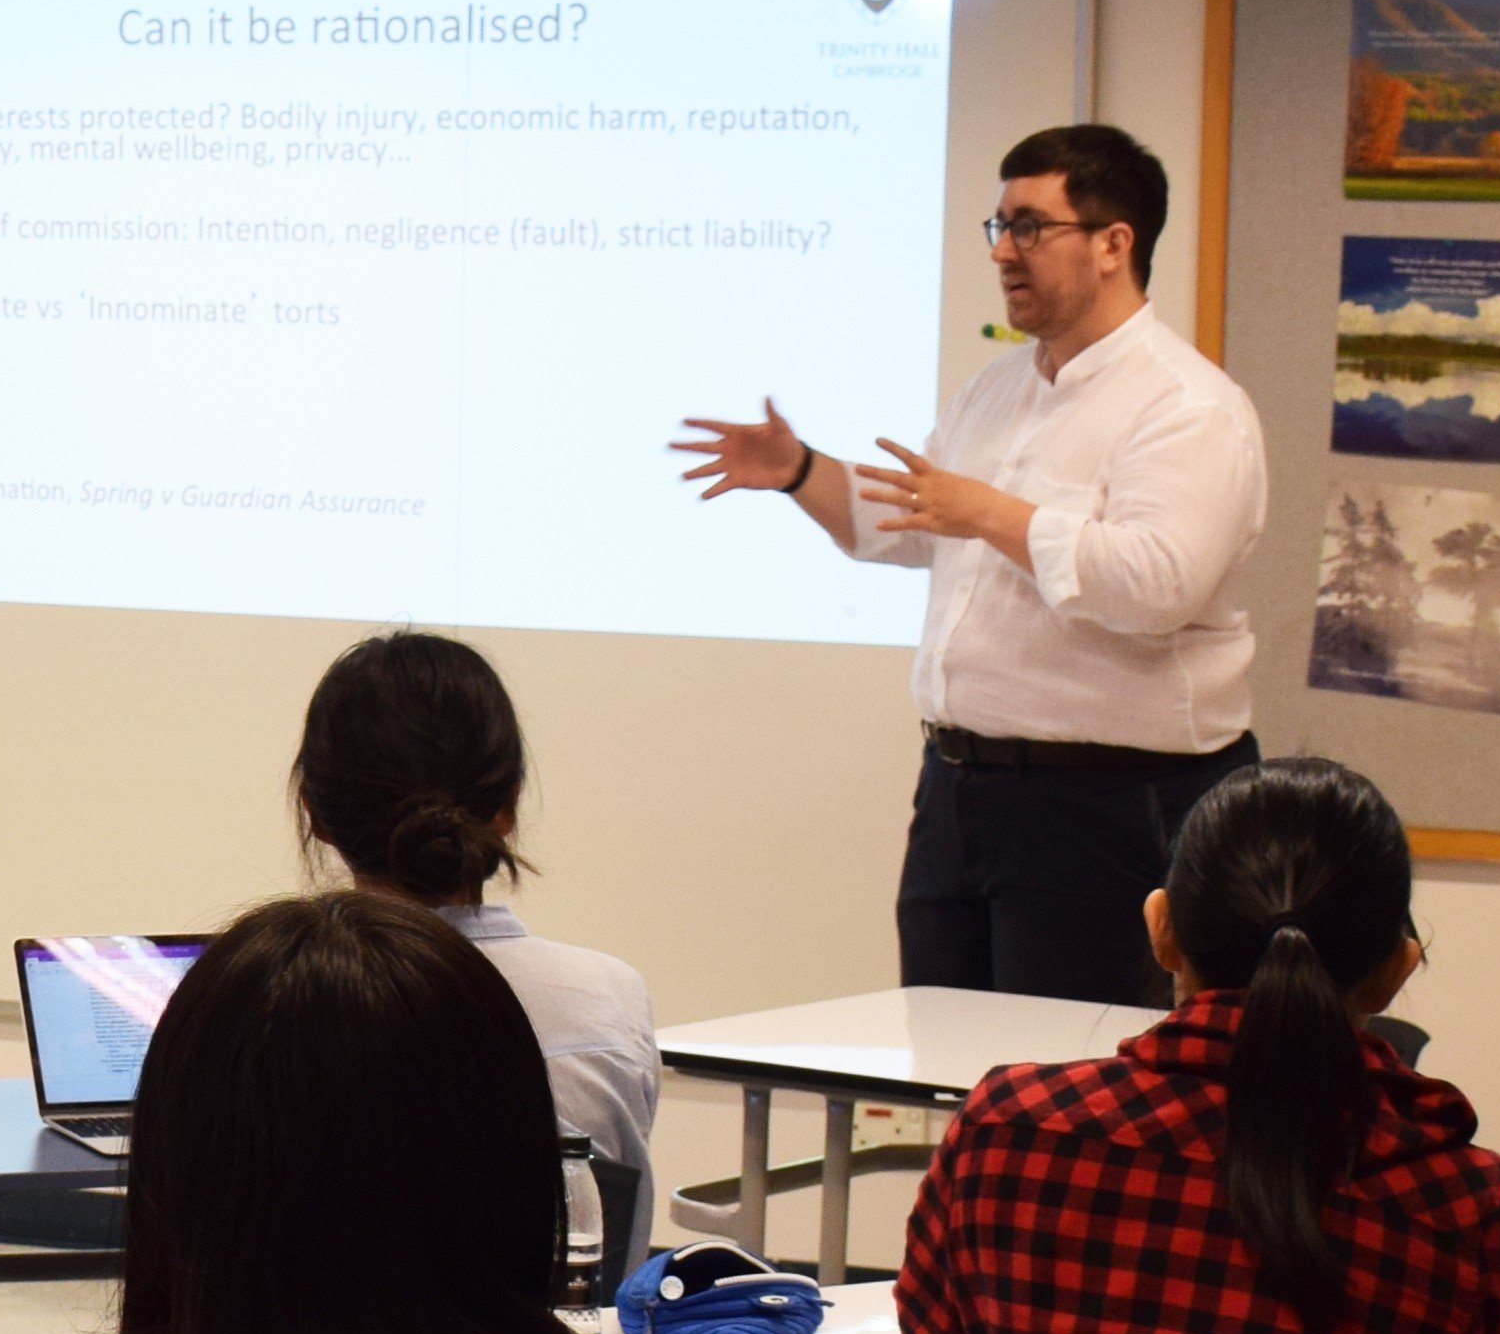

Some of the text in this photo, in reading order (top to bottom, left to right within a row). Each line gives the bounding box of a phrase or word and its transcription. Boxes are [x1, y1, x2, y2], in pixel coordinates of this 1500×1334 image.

[118, 2, 588, 46] Can it be rationalised?
[80, 102, 231, 136] protected?
[241, 102, 327, 138] Bodily
[337, 104, 426, 136] injury,
[436, 103, 579, 131] economic
[589, 103, 677, 135] harm,
[687, 103, 859, 136] reputation,
[30, 135, 124, 161] mental
[134, 135, 275, 168] wellbeing,
[18, 214, 188, 241] commission:
[198, 217, 334, 246] Intention,
[346, 217, 501, 251] negligence
[510, 217, 607, 251] (fault),
[619, 220, 693, 247] strict
[704, 219, 832, 255] liability?
[36, 299, 63, 320] vs
[274, 301, 340, 325] torts
[79, 480, 154, 512] Spring
[162, 490, 174, 505] v
[181, 485, 292, 510] Guardian
[298, 489, 426, 517] Assurance
